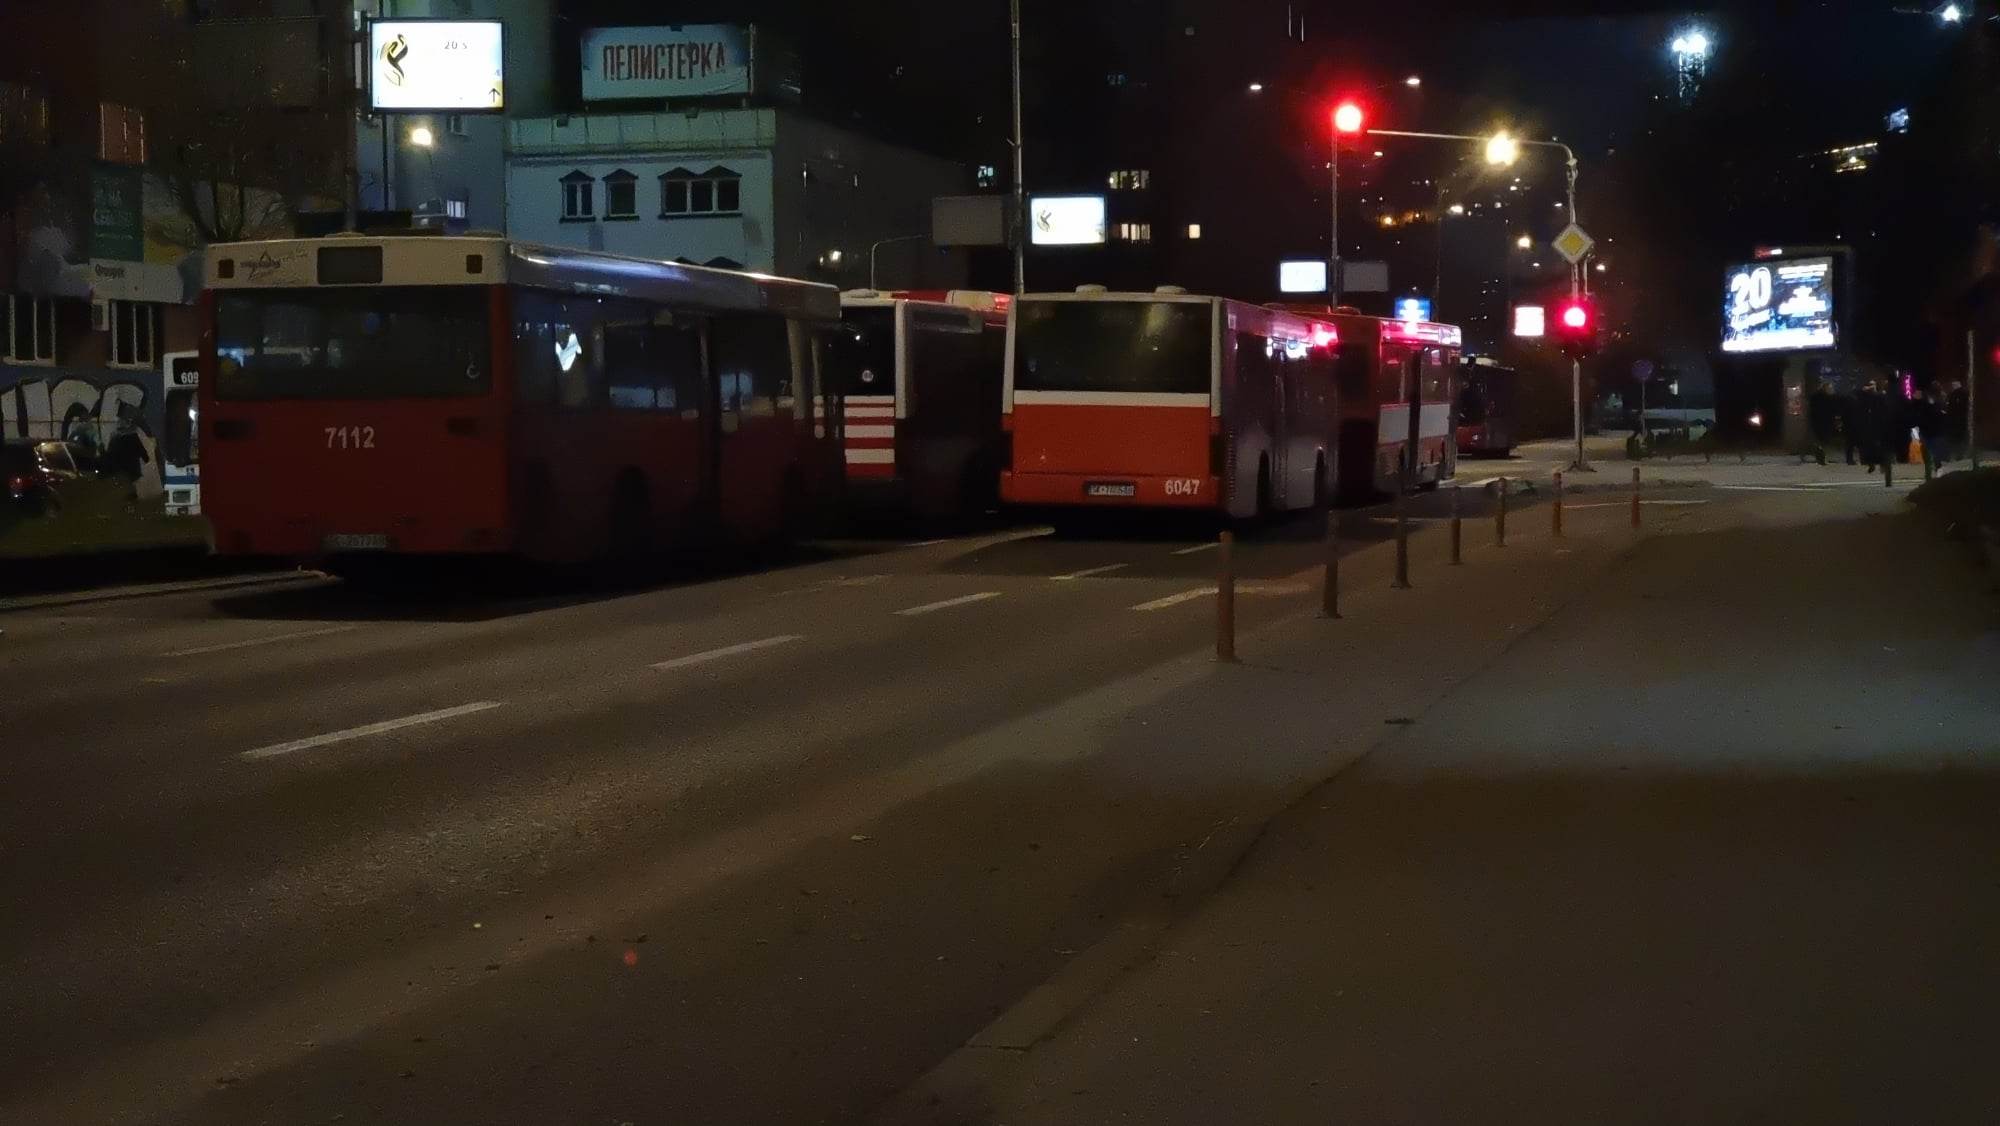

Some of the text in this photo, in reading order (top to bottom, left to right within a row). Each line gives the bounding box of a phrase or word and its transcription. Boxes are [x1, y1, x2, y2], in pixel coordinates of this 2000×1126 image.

[603, 41, 726, 81] ПЕЛИСТЕРКА
[1730, 266, 1772, 316] 20
[324, 425, 376, 449] 7112
[1164, 478, 1201, 496] 6047
